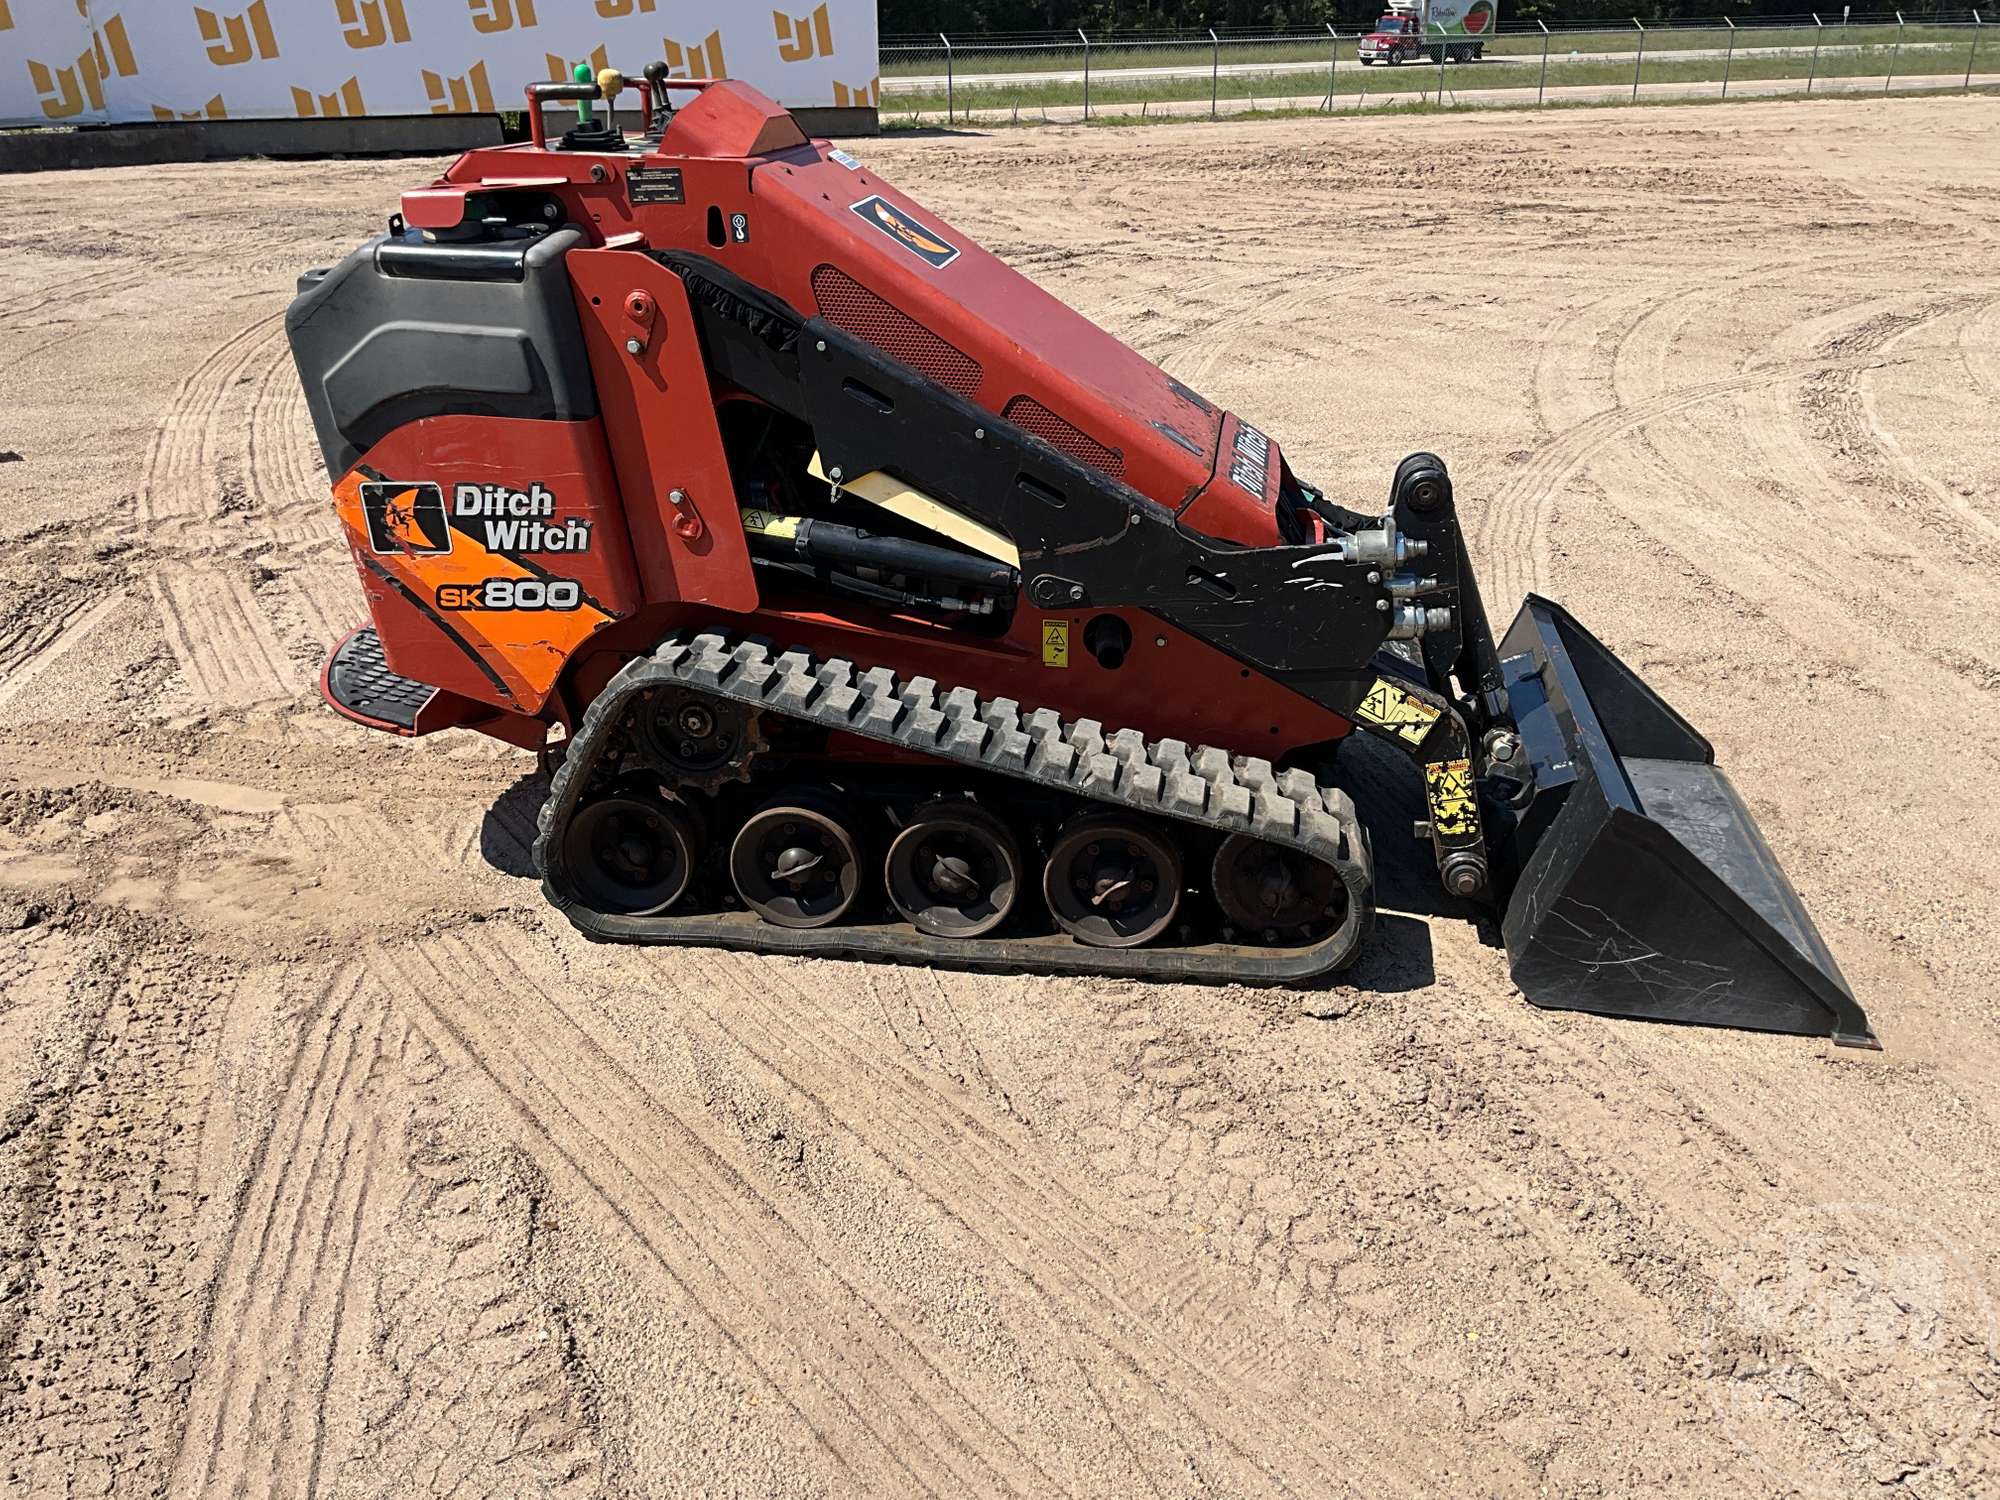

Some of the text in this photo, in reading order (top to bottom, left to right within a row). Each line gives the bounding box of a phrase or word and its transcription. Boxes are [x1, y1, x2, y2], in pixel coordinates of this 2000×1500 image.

[455, 485, 552, 516] Ditch
[484, 520, 588, 550] Witch
[439, 581, 579, 608] SK800
